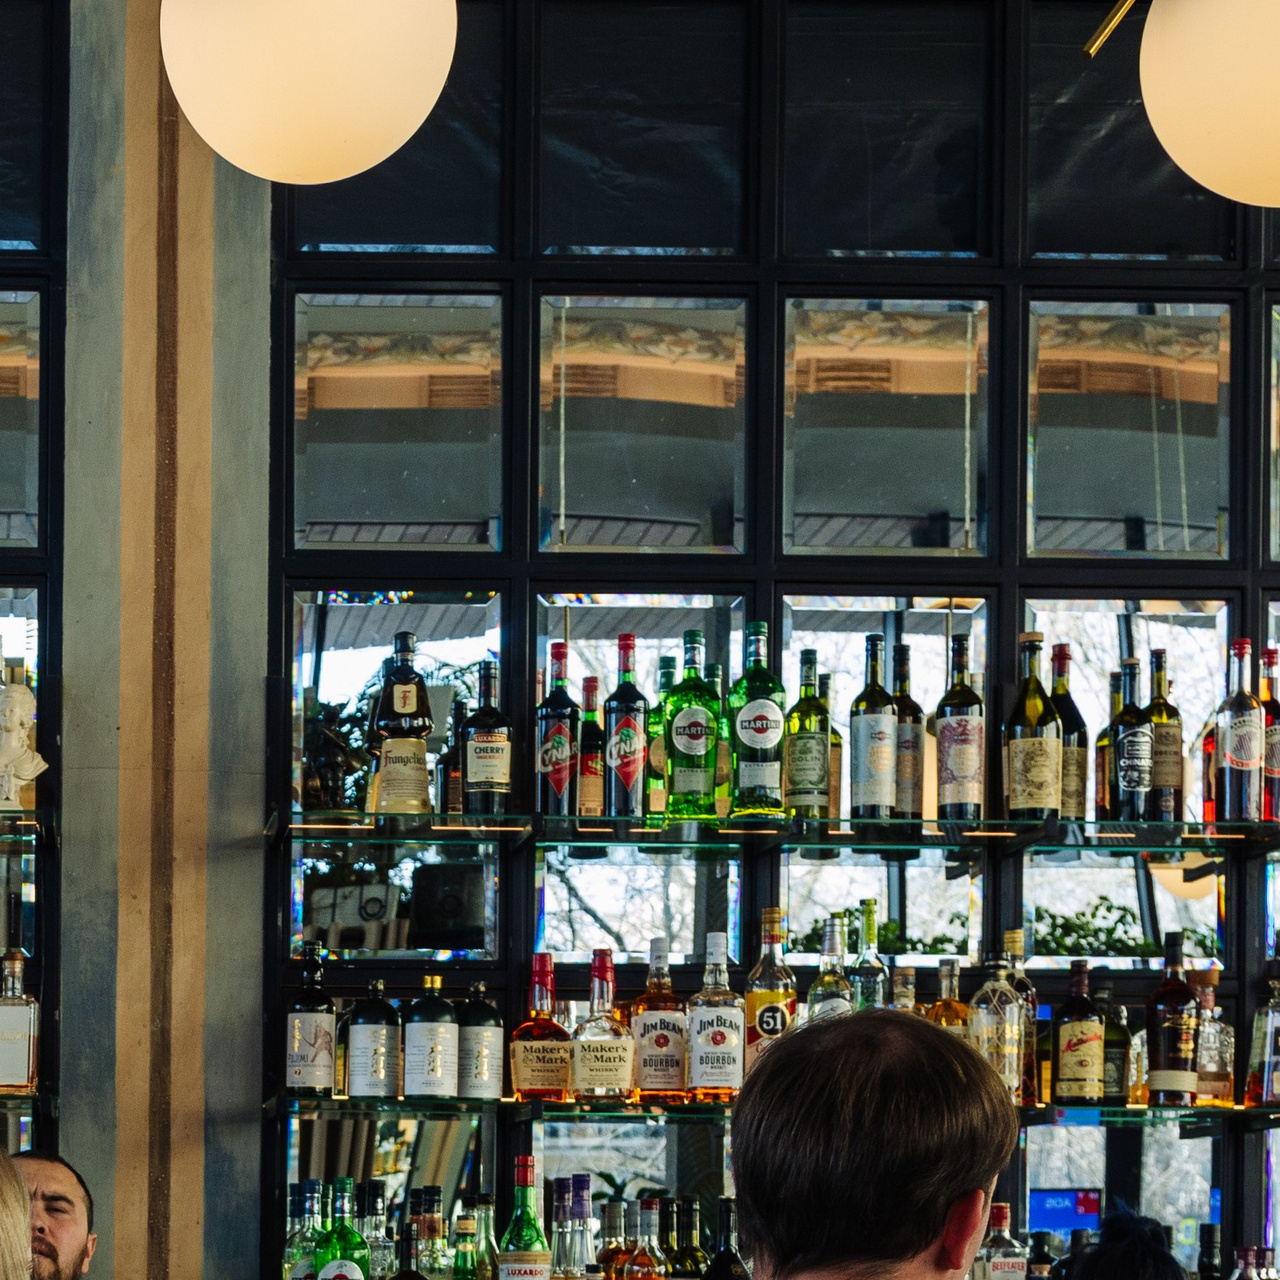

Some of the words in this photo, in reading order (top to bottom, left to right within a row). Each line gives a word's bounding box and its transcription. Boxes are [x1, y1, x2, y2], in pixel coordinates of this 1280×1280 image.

[741, 720, 780, 729] MARTINI
[474, 747, 505, 755] CHERRY
[697, 1019, 715, 1035] JIM
[716, 1015, 740, 1035] BEAM
[762, 1012, 782, 1030] 51
[640, 1021, 658, 1038] JIM
[659, 1018, 684, 1038] BEAM
[522, 1044, 568, 1054] Maker's
[580, 1043, 627, 1053] Maker's
[535, 1054, 568, 1064] Mark
[593, 1053, 627, 1063] Mark
[642, 1058, 680, 1068] BOURBON
[699, 1055, 736, 1065] BOURBON
[992, 1261, 1025, 1271] BEEFEATER
